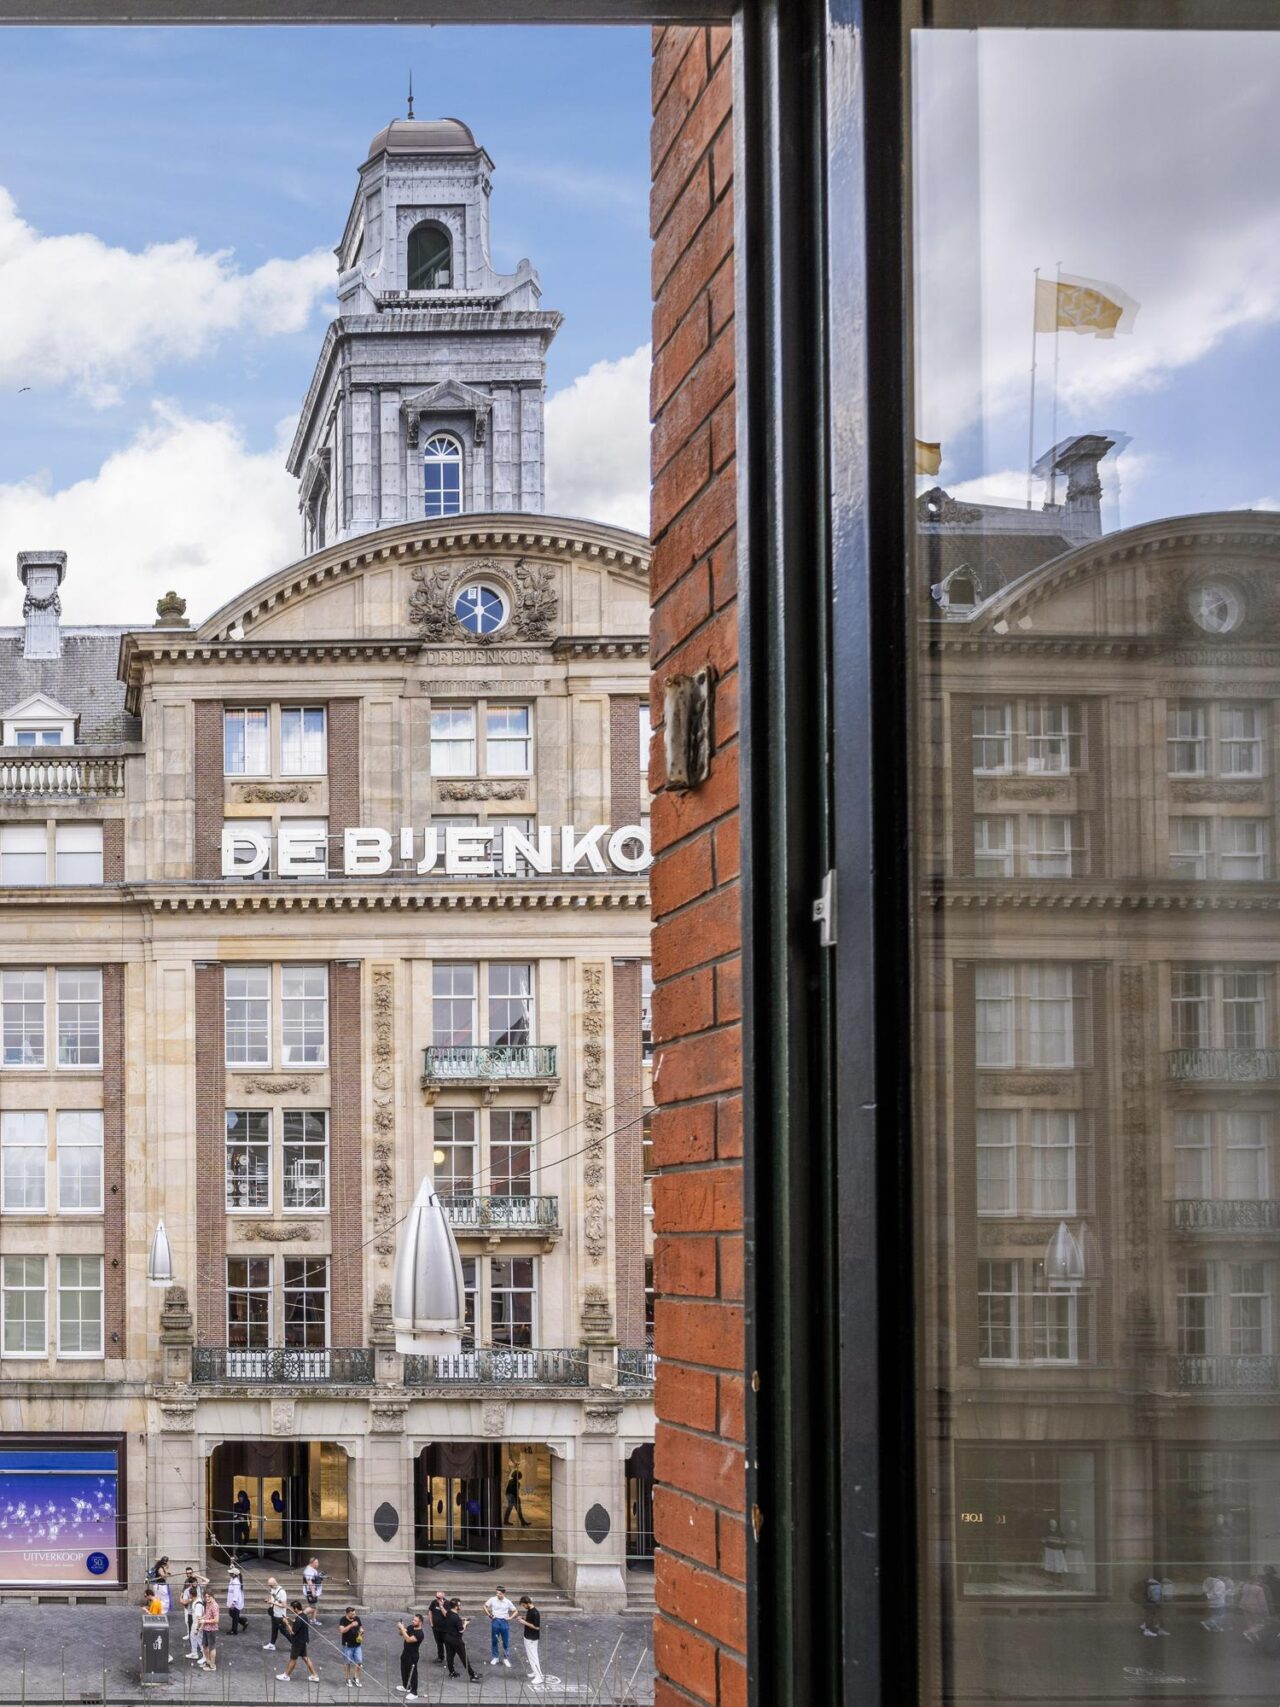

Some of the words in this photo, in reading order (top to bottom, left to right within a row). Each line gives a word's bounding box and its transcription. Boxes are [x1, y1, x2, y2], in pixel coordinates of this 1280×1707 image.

[221, 828, 326, 876] DE
[344, 825, 654, 876] BIJENKO
[23, 1552, 84, 1561] UITVERKOOP
